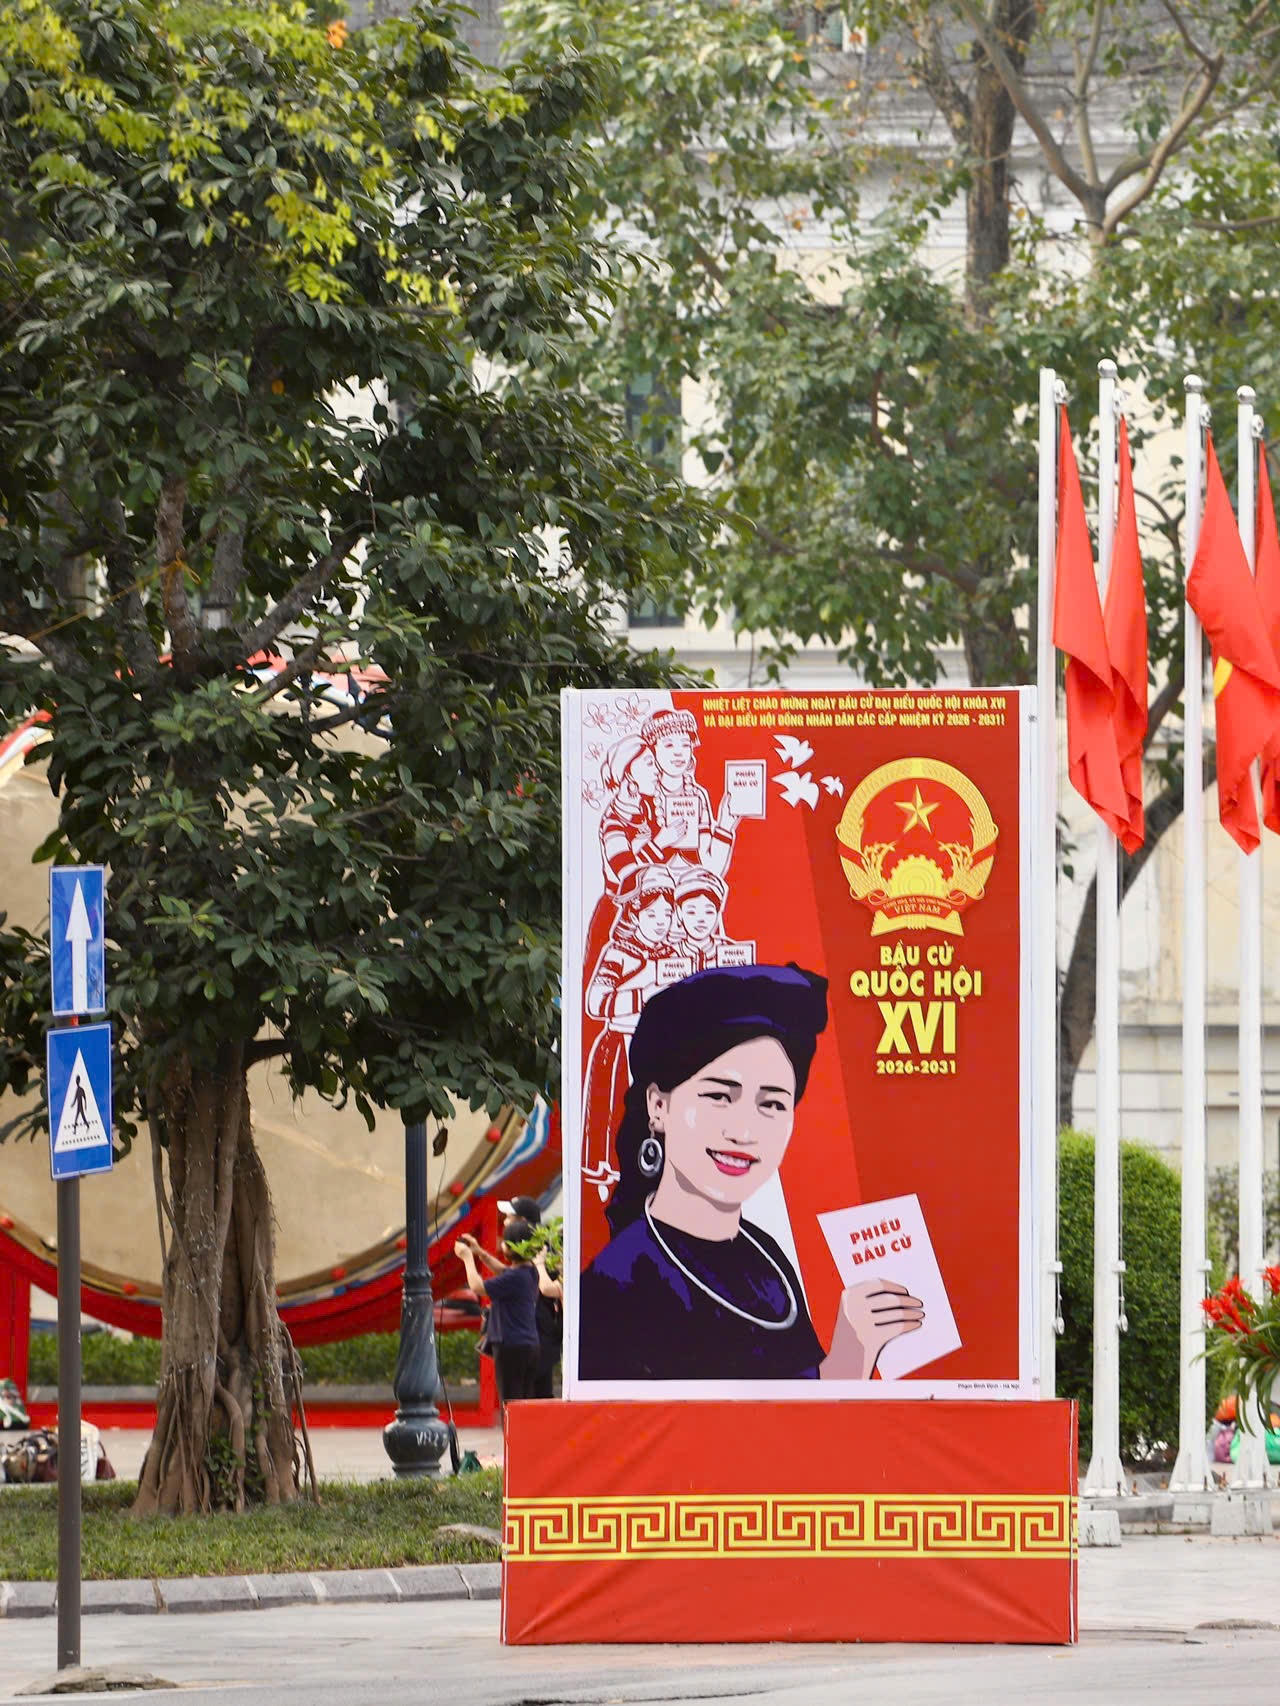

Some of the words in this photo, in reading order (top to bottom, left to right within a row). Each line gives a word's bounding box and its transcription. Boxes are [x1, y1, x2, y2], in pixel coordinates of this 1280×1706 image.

[990, 696, 1006, 710] XVI
[947, 713, 970, 726] 2026
[919, 903, 941, 915] NAM
[880, 939, 921, 967] BẦU
[926, 940, 954, 966] CỬ
[850, 963, 925, 998] QUỐC
[933, 965, 982, 1003] HỘI
[876, 1001, 956, 1054] XVI
[876, 1060, 957, 1075] 2026-2031
[849, 1217, 902, 1246] PHIẾU
[890, 1233, 913, 1254] CỬ
